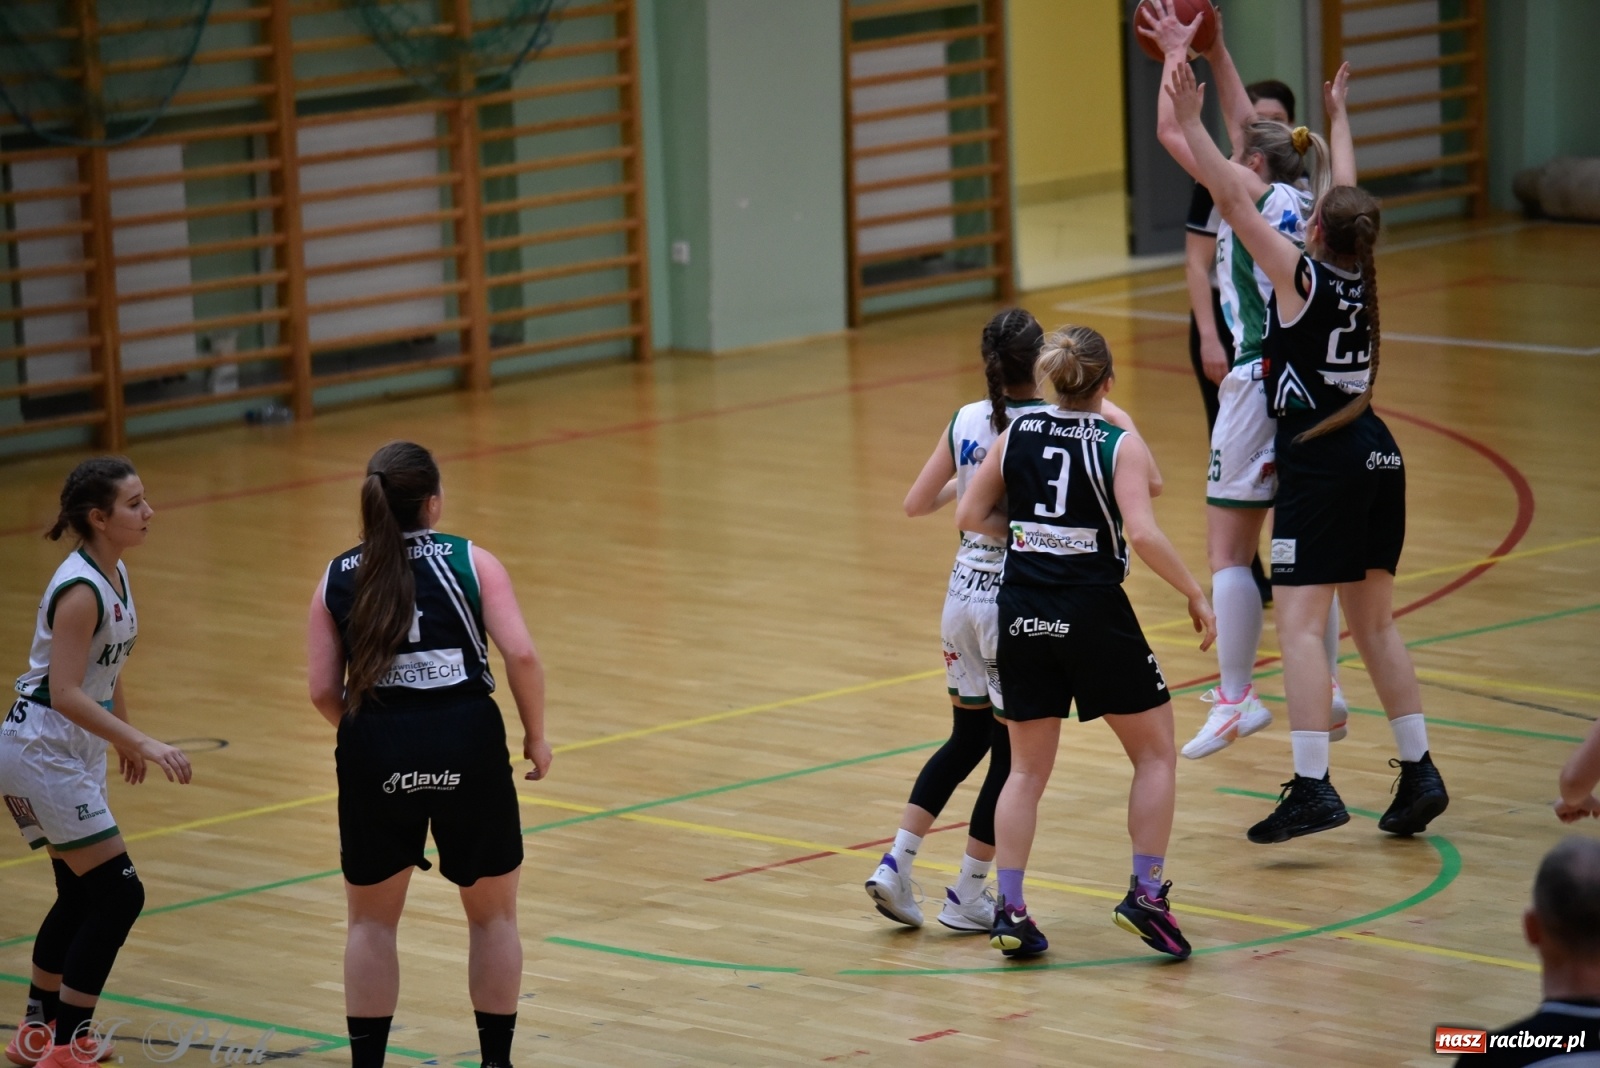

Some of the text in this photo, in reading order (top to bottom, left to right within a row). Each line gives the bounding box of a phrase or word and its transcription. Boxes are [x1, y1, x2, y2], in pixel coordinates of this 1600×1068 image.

[1019, 419, 1046, 433] RKK
[1034, 446, 1071, 518] 3
[341, 552, 368, 572] RK
[1023, 617, 1071, 634] Clavis
[1147, 653, 1166, 691] 3
[401, 769, 461, 789] Clavis
